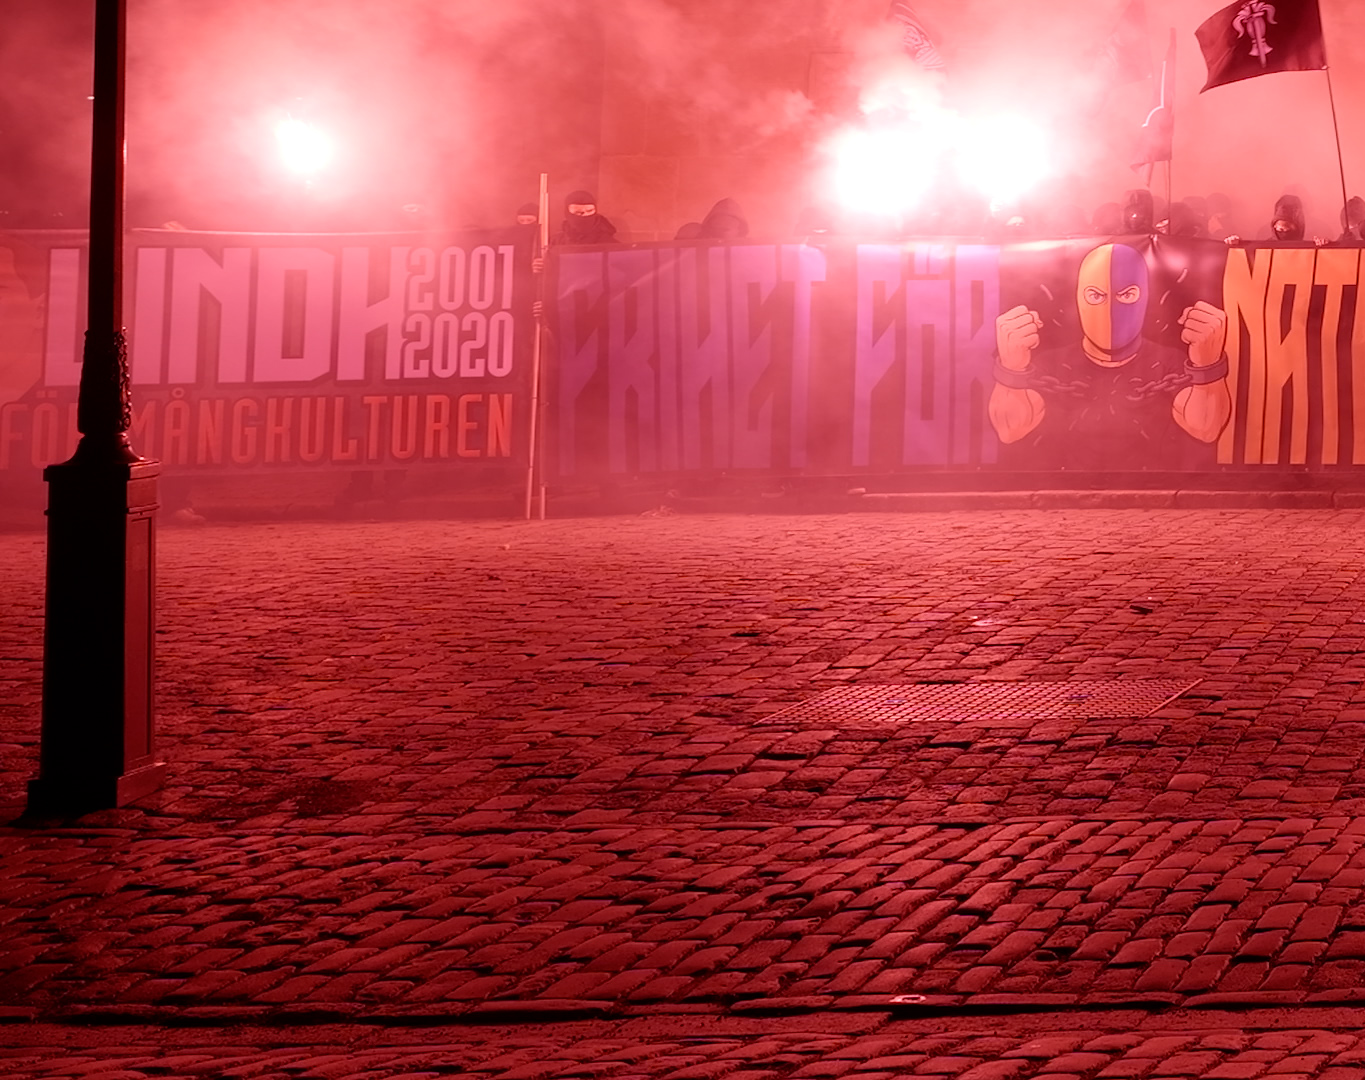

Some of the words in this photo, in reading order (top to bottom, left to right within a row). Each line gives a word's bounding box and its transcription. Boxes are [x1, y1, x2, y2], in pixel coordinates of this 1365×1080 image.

[406, 245, 514, 311] 2001
[404, 311, 514, 380] 2020
[558, 243, 827, 475] FRIHET
[852, 243, 1000, 467] FÖR
